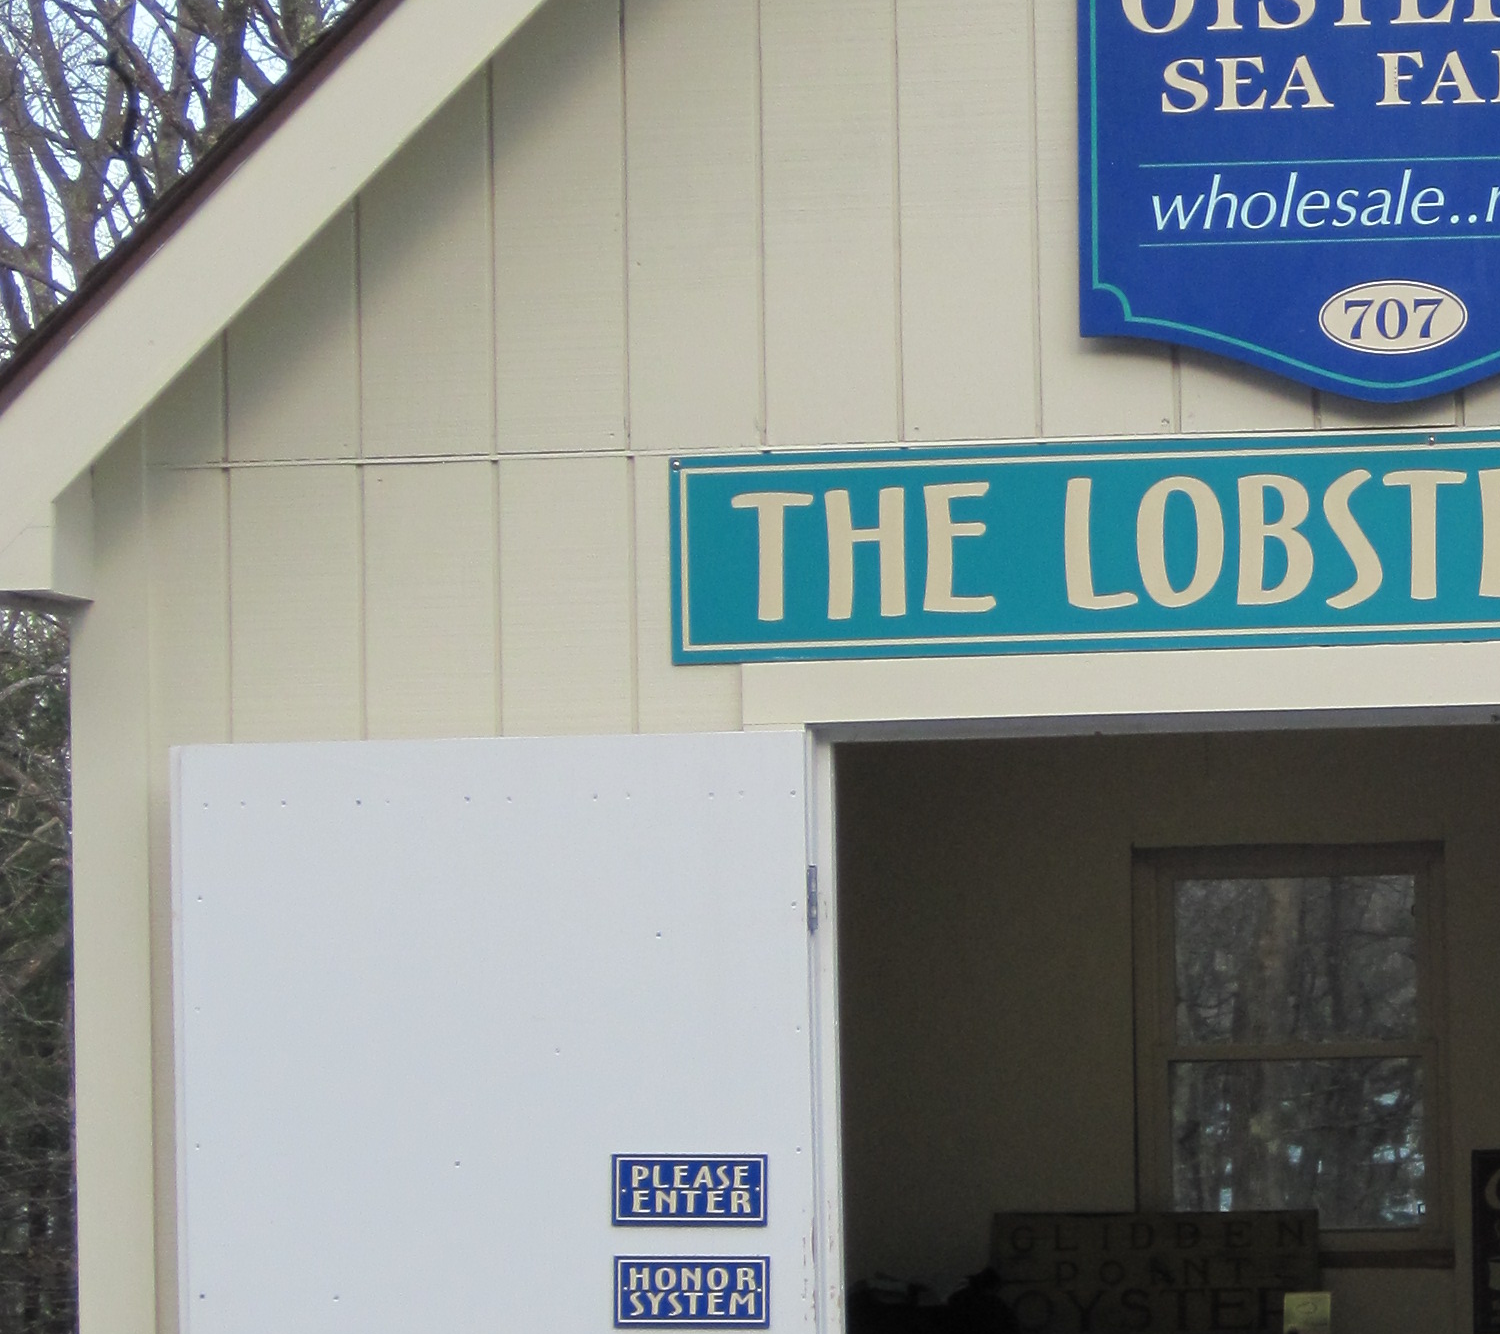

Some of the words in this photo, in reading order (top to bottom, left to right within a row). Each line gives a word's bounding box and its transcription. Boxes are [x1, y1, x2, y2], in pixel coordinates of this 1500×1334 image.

[1160, 51, 1335, 114] SEA
[1343, 297, 1445, 340] 707
[731, 481, 997, 622] THE
[631, 1164, 750, 1189] PLEASE
[631, 1190, 752, 1214] ENTER
[1009, 1220, 1306, 1254] GLIDDEN
[629, 1267, 757, 1291] HONOR
[629, 1291, 756, 1316] SYSTEM
